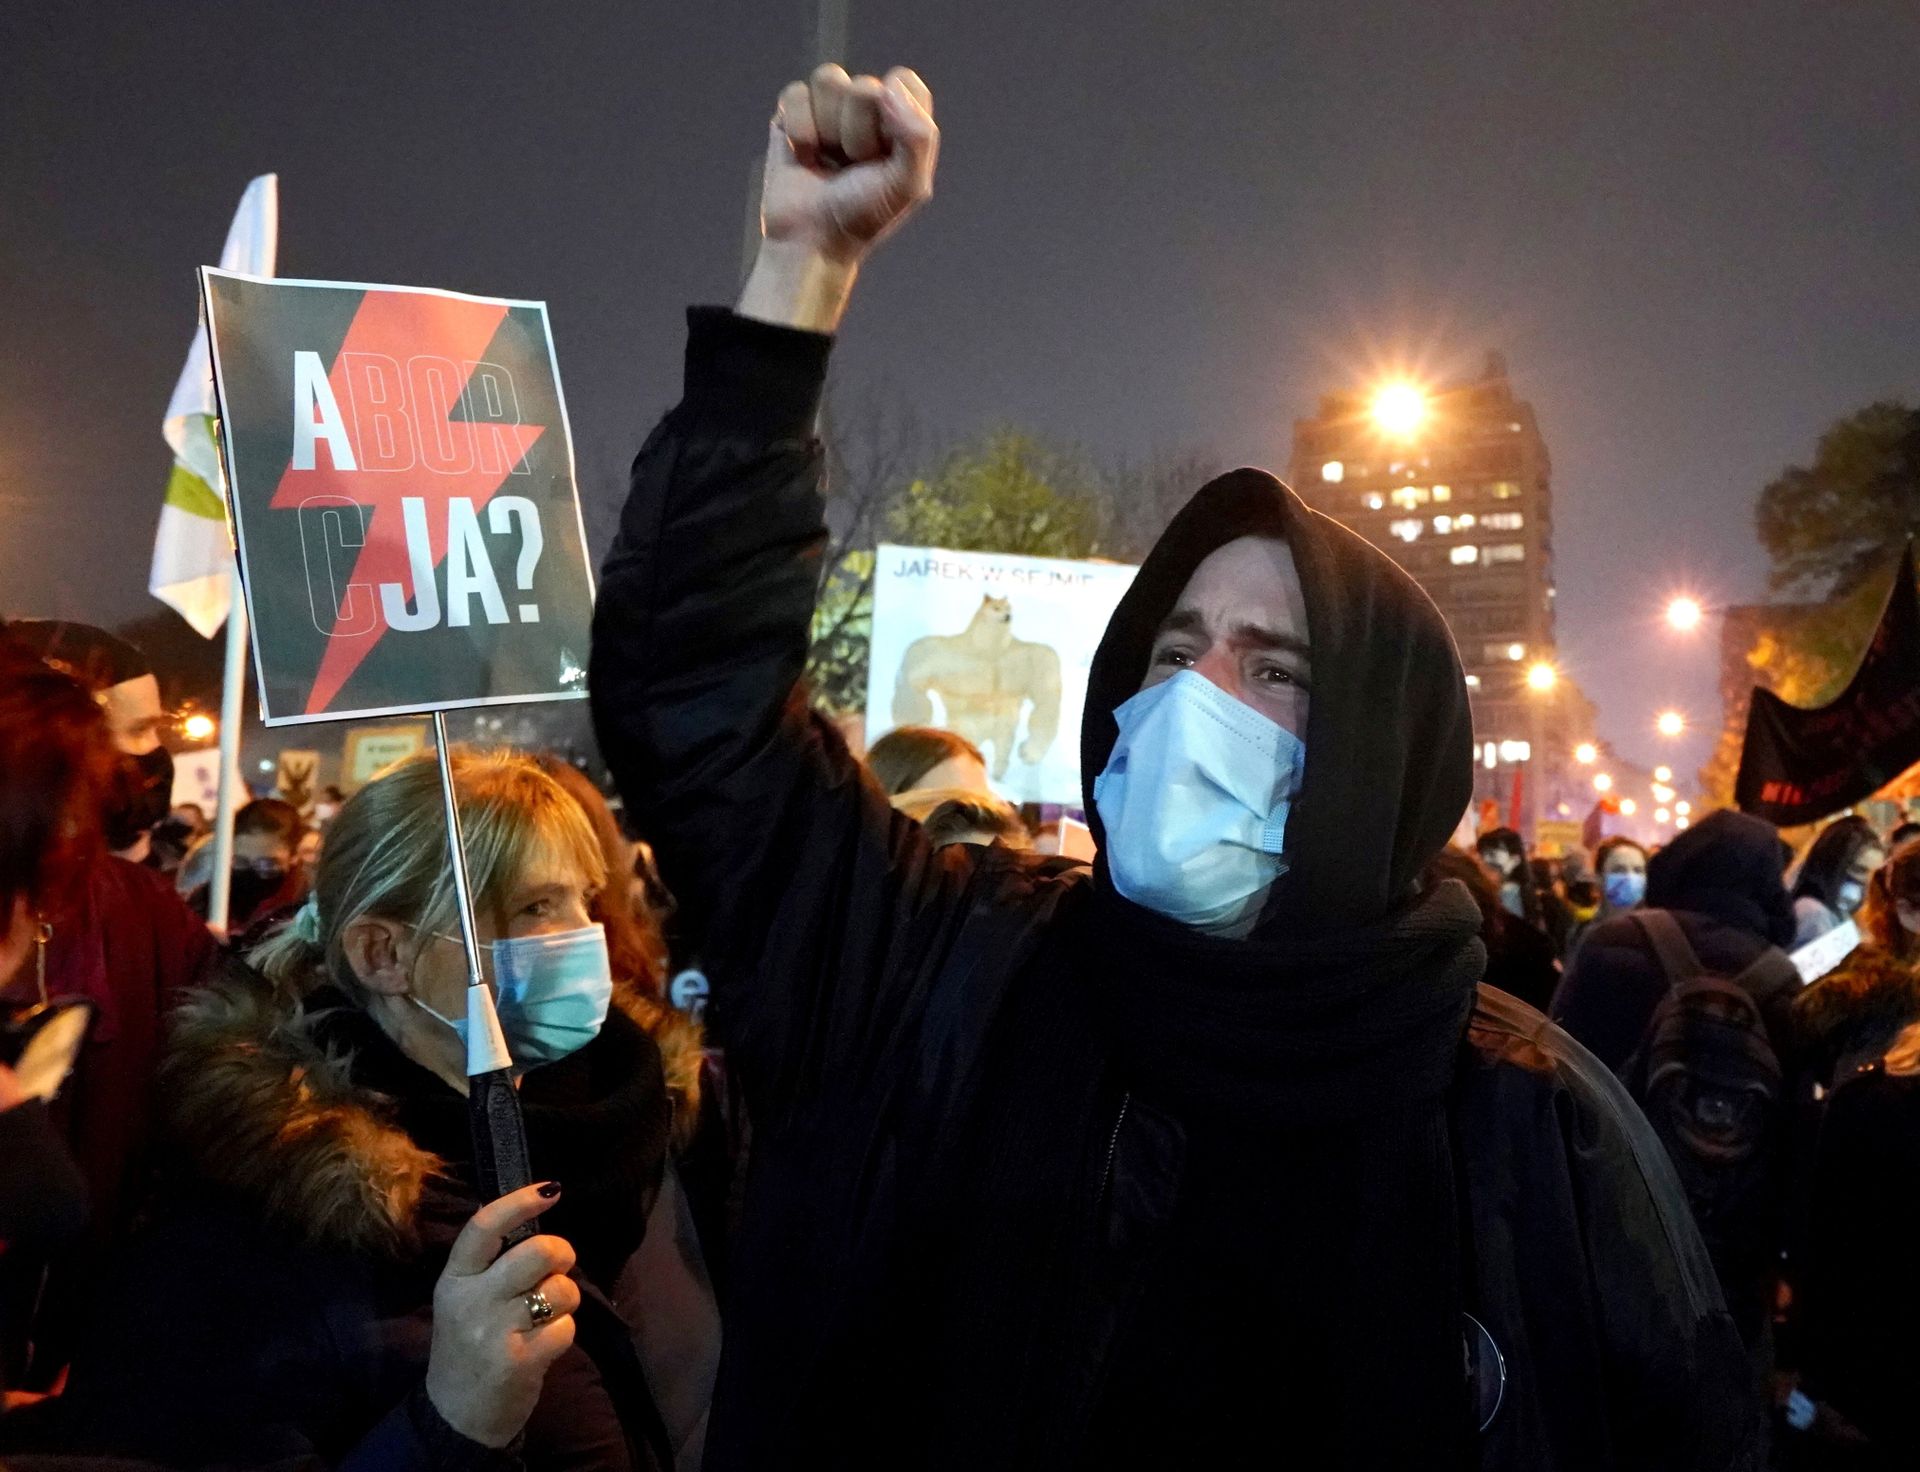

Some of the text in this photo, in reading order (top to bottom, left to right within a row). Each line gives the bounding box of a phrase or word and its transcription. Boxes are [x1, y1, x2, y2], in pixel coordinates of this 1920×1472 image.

[291, 350, 531, 475] ABOR
[297, 494, 544, 637] CJA?
[893, 559, 974, 581] JAREK
